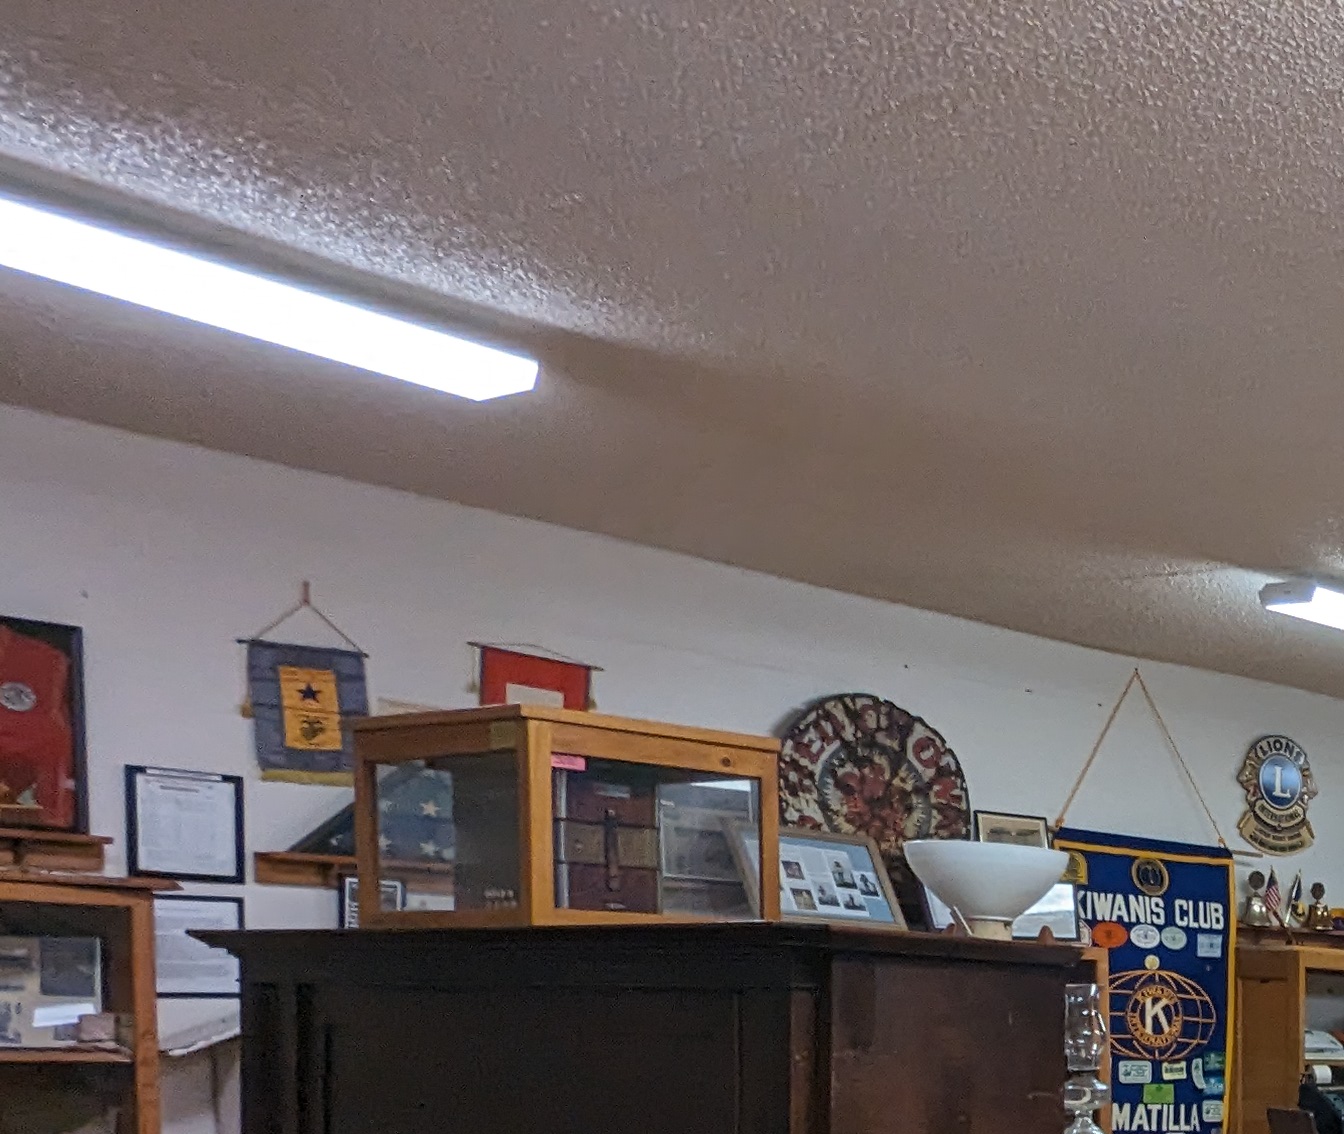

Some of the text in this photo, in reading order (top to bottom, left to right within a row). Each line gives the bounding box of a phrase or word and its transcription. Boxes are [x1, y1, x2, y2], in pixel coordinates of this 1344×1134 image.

[1272, 765, 1291, 798] L
[1174, 898, 1225, 931] CLUB
[1145, 997, 1171, 1036] K
[1112, 1102, 1201, 1132] MATILLA
